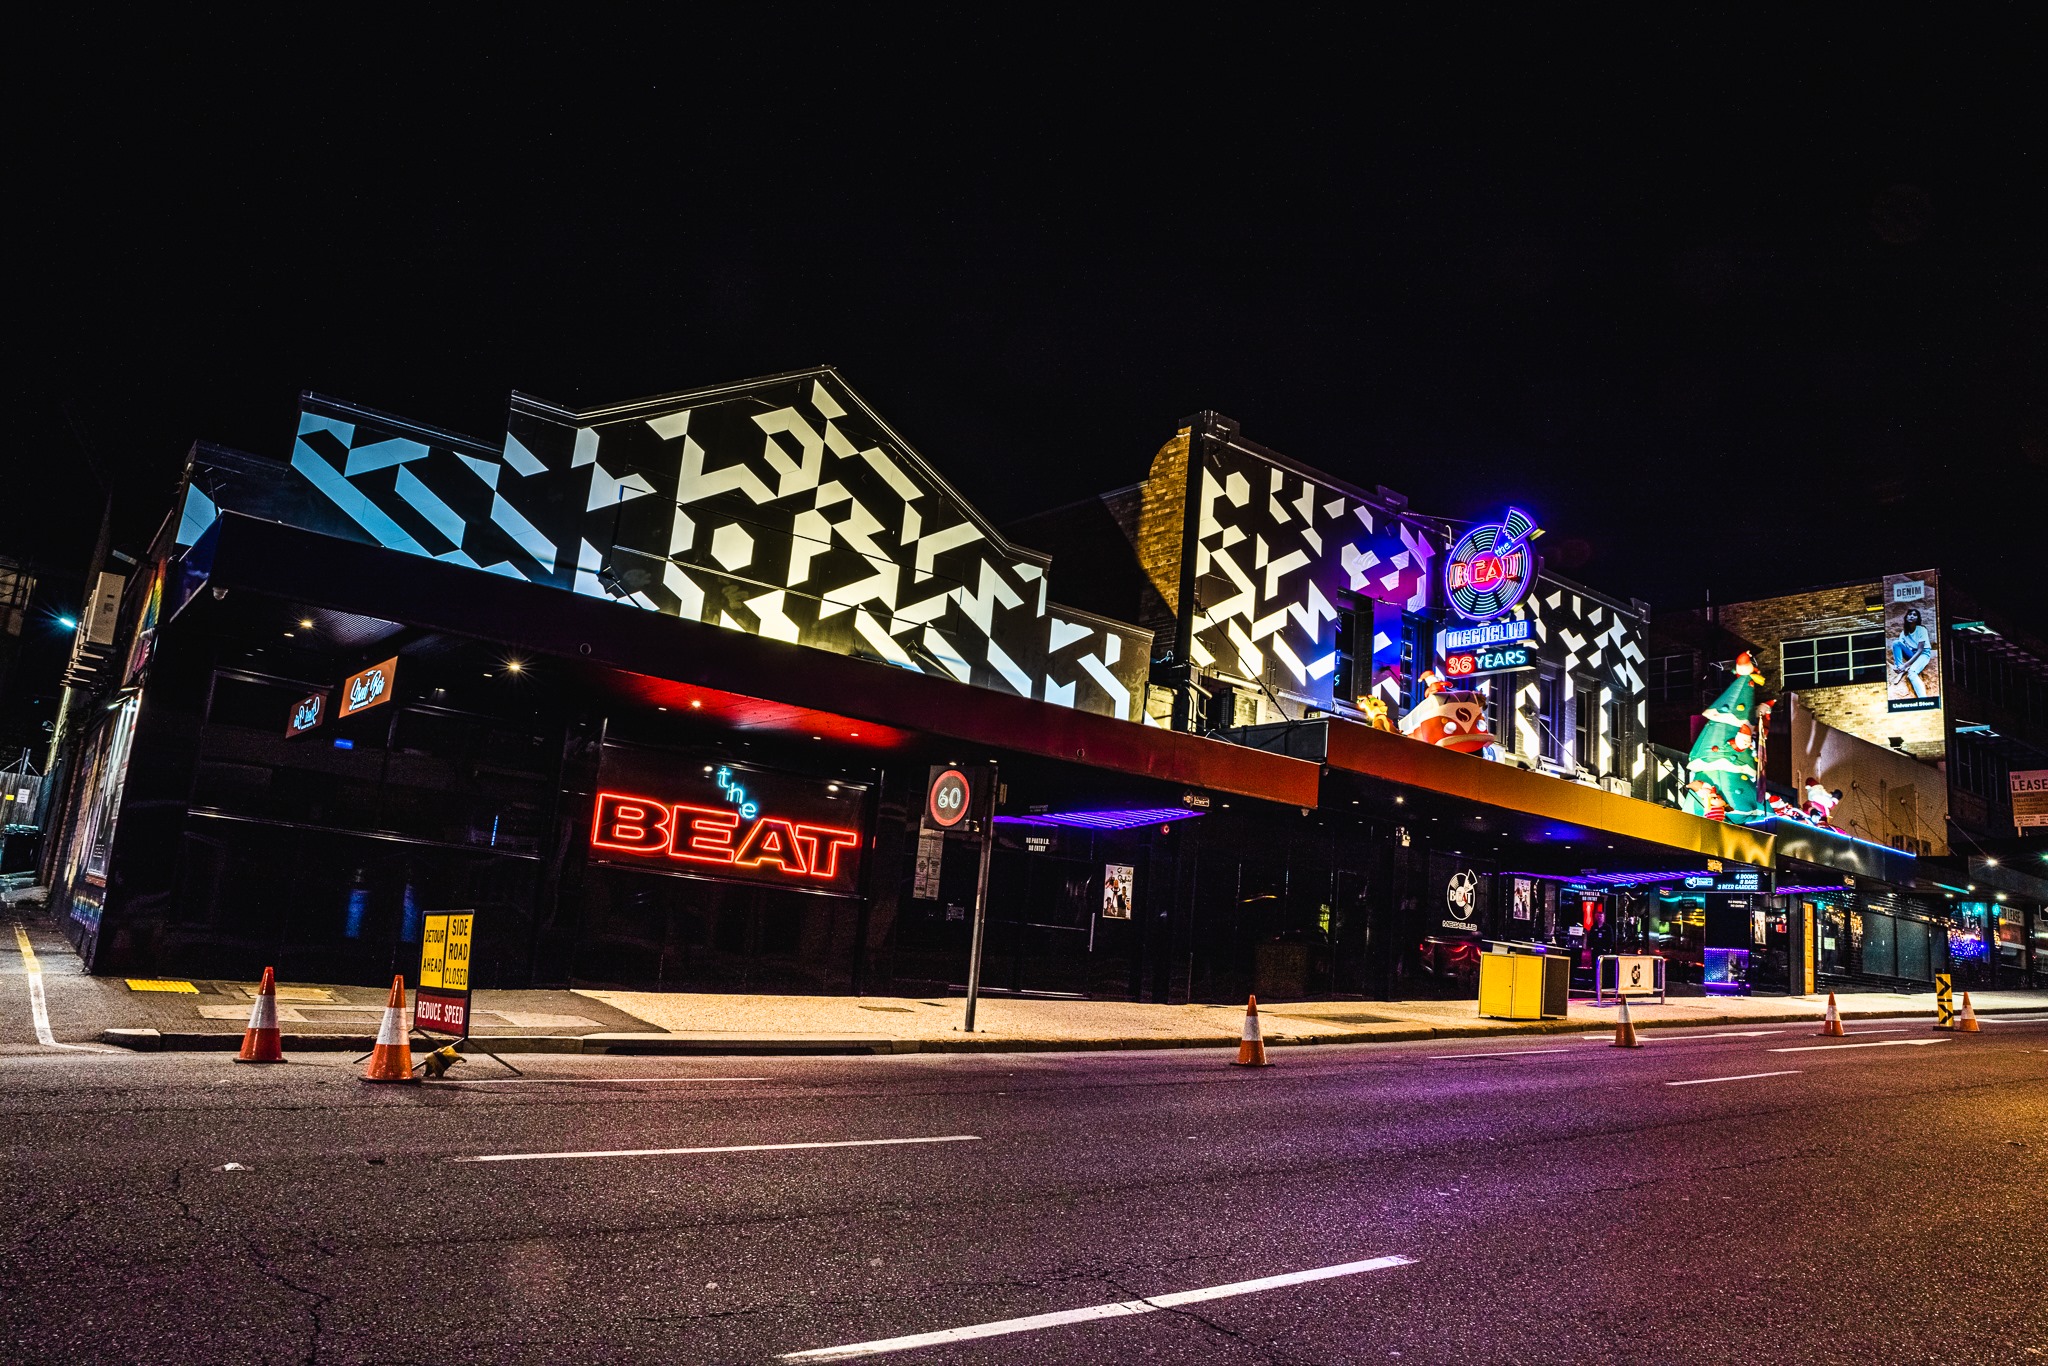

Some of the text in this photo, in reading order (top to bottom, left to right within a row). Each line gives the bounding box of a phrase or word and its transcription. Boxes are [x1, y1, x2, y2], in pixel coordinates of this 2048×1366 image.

[1495, 541, 1511, 557] the
[1450, 553, 1522, 588] BEAT
[1896, 586, 1922, 597] DENIM
[1446, 621, 1527, 648] MEGACLUB
[1448, 650, 1526, 674] 36 YEARS
[349, 677, 371, 711] Street
[717, 766, 757, 819] the
[2012, 779, 2048, 791] LEASE
[937, 787, 961, 808] 60
[592, 792, 857, 878] BEAT
[425, 929, 445, 943] DETOUR
[452, 919, 468, 936] SIDE
[448, 943, 468, 960] ROAD
[422, 958, 442, 972] AHEAD
[444, 967, 467, 985] CLOSED
[418, 1001, 464, 1024] REDUCE SPEED
